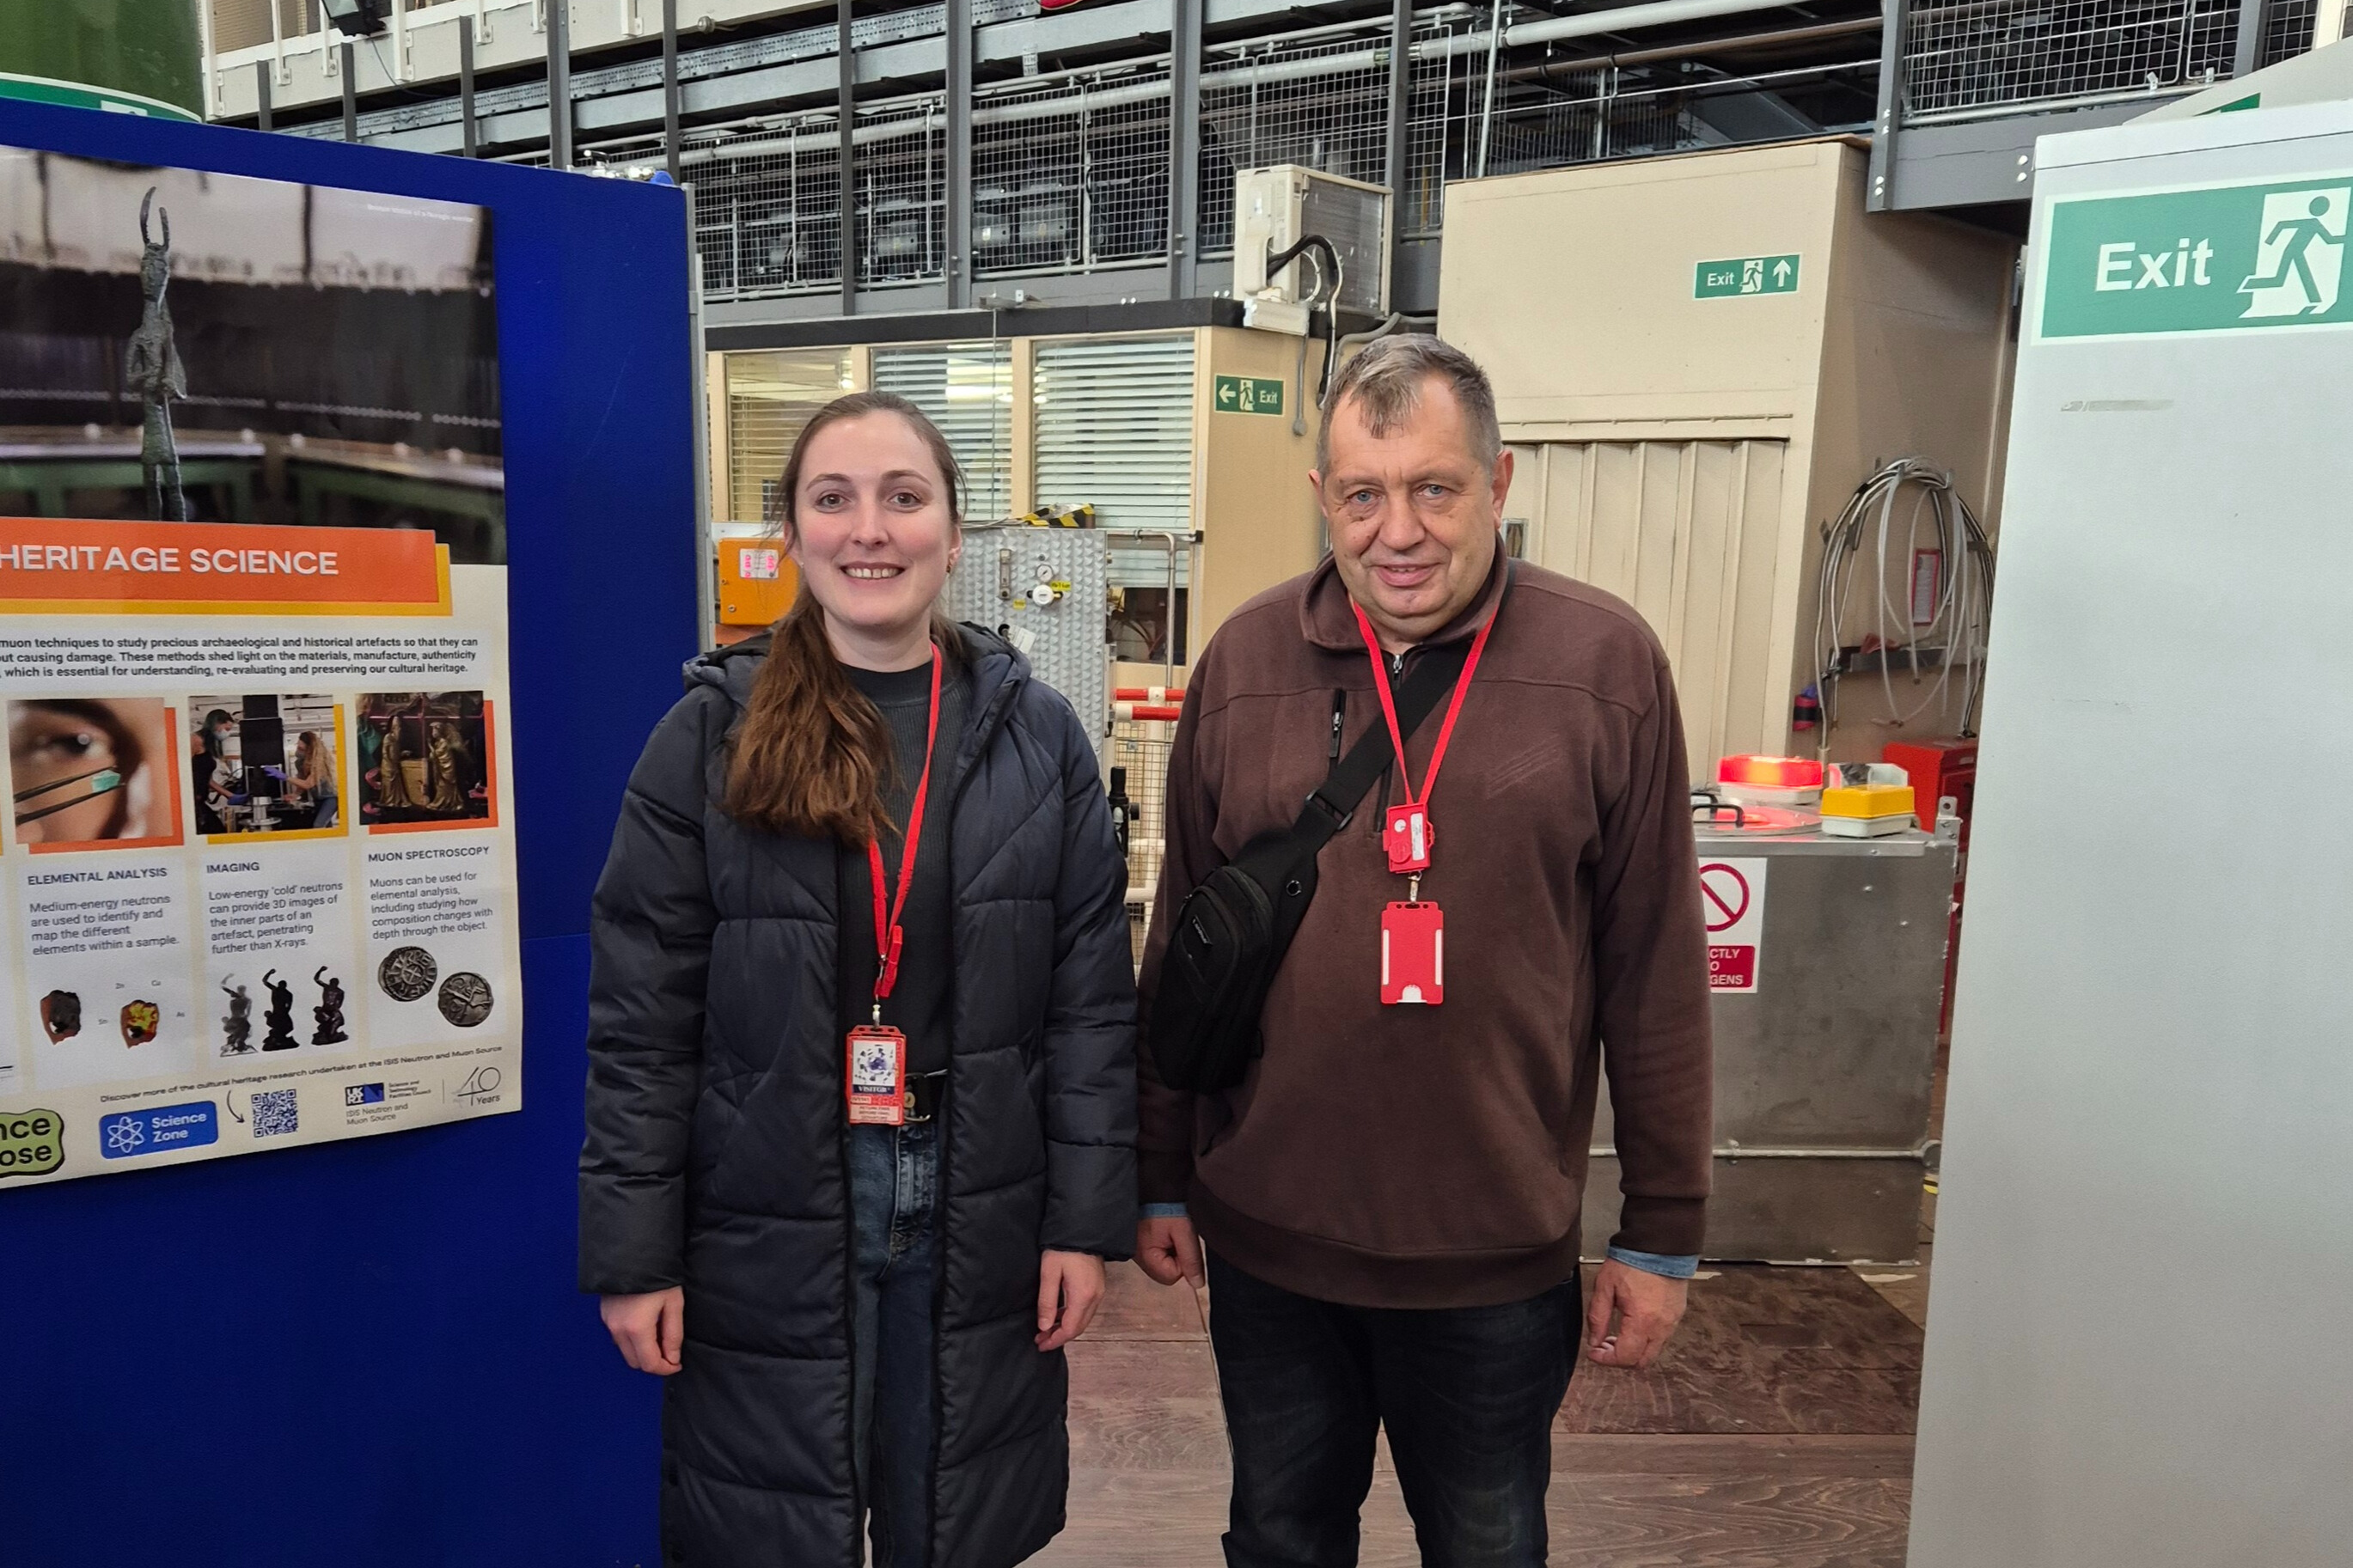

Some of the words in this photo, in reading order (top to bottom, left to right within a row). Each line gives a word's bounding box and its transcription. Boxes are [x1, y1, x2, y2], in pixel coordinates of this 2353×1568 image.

[2094, 237, 2215, 292] Exit
[1707, 272, 1735, 287] Exit
[1259, 389, 1278, 404] Exit
[0, 544, 181, 573] HERITAGE
[190, 548, 339, 576] SCIENCE
[0, 639, 32, 648] muon
[34, 638, 99, 650] techniques
[102, 638, 114, 648] to
[117, 638, 148, 650] study
[150, 638, 199, 650] precious
[202, 637, 279, 649] archaeological
[282, 638, 301, 647] and
[304, 637, 352, 647] historical
[356, 638, 401, 647] artefacts
[418, 638, 437, 647] that
[439, 638, 460, 649] they
[0, 653, 14, 662] ut
[17, 652, 63, 664] causing
[66, 652, 116, 664] damage.
[119, 651, 154, 662] These
[157, 651, 205, 662] methods
[208, 651, 234, 661] shed
[237, 650, 260, 663] light
[279, 651, 296, 661] the
[299, 651, 351, 662] materials,
[353, 651, 419, 662] manufacture,
[422, 650, 476, 662] authenticity
[4, 666, 40, 677] which
[43, 667, 53, 677] is
[57, 666, 108, 677] essential
[112, 666, 128, 676] for
[131, 665, 214, 677] understanding,
[217, 665, 286, 676] re-evaluating
[290, 665, 309, 674] and
[311, 665, 367, 675] preserving
[388, 663, 425, 673] cultural
[428, 663, 468, 674] heritage.
[368, 851, 403, 863] MUON
[406, 846, 490, 860] SPECTROSCOPY
[28, 871, 103, 885] ELEMENTAL
[107, 868, 168, 881] ANALYSIS
[206, 862, 260, 874] IMAGING
[370, 878, 404, 888] Muons
[406, 877, 424, 886] can
[425, 875, 437, 884] be
[439, 873, 461, 883] used
[464, 871, 478, 881] for
[209, 888, 269, 901] Low-energy
[300, 882, 343, 894] neutrons
[370, 889, 418, 901] elemental
[420, 887, 461, 898] analysis,
[29, 899, 119, 912] Medium-energy
[121, 895, 171, 907] neutrons
[209, 906, 229, 914] can
[232, 901, 271, 914] provide
[272, 899, 286, 909] 3D
[289, 895, 325, 908] images
[327, 894, 338, 904] of
[371, 903, 415, 914] including
[418, 900, 456, 911] studying
[459, 897, 479, 906] how
[31, 918, 50, 927] are
[52, 914, 81, 926] used
[83, 914, 95, 924] to
[98, 911, 140, 923] identify
[143, 908, 163, 919] and
[210, 918, 228, 928] the
[229, 916, 256, 926] inner
[259, 912, 284, 925] parts
[287, 911, 297, 921] of
[372, 914, 431, 927] composition
[433, 910, 472, 922] changes
[474, 908, 493, 918] with
[32, 931, 58, 943] map
[60, 929, 79, 939] the
[82, 925, 131, 938] different
[211, 930, 254, 941] artefact,
[257, 924, 314, 938] penetrating
[372, 929, 400, 941] depth
[402, 925, 438, 937] through
[440, 924, 455, 933] the
[457, 921, 487, 933] object.
[33, 943, 86, 955] elements
[89, 939, 123, 951] within
[125, 940, 133, 949] a
[136, 936, 180, 948] sample.
[211, 944, 248, 955] further
[250, 941, 272, 951] than
[1709, 948, 1740, 959] CTLY
[1710, 973, 1744, 985] GENS
[101, 1092, 142, 1103] Discover
[143, 1088, 166, 1097] more
[168, 1085, 178, 1094] of
[197, 1079, 231, 1090] cultural
[231, 1074, 267, 1086] heritage
[269, 1069, 307, 1081] research
[309, 1064, 357, 1075] undertaken
[400, 1054, 434, 1065] Neutron
[436, 1052, 450, 1060] and
[452, 1048, 474, 1058] Muon
[475, 1046, 502, 1055] Source
[346, 1087, 364, 1096] UK
[476, 1095, 500, 1106] Years
[345, 1108, 361, 1118] ISIS
[362, 1106, 393, 1115] Neutron
[346, 1117, 369, 1126] Muon
[370, 1113, 396, 1123] Source
[151, 1113, 207, 1129] Science
[152, 1130, 189, 1144] Zone
[0, 1145, 52, 1167] ose
